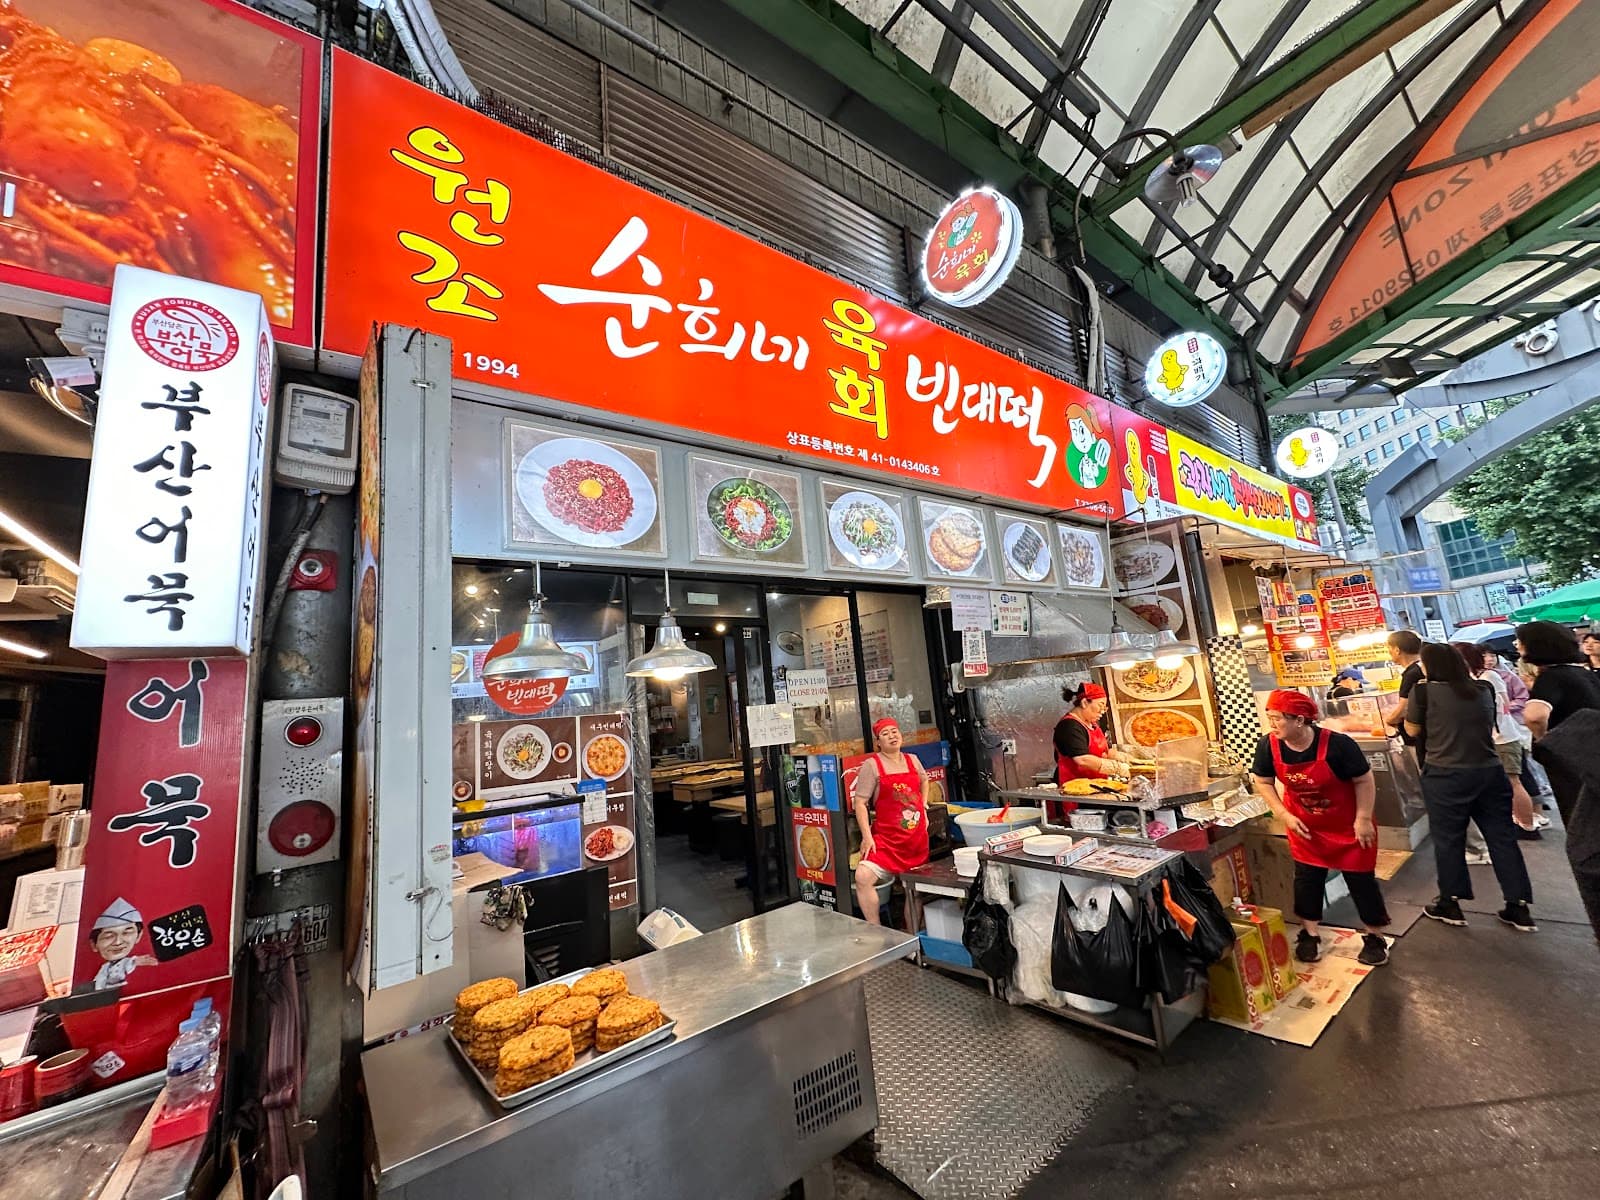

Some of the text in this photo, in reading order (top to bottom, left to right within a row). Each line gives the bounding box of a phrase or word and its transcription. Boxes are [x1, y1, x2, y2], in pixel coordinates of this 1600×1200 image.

[932, 245, 976, 280] 순희네
[955, 249, 989, 280] 육회
[137, 302, 162, 321] BUSAN
[163, 298, 199, 308] EOMUK
[389, 126, 512, 322] 원조
[537, 216, 810, 371] 순희네
[822, 298, 889, 440] 육회
[905, 355, 1057, 488] 빈대떡
[157, 326, 201, 349] 부산
[170, 341, 221, 365] 어묵
[463, 352, 520, 379] 1994
[786, 431, 855, 457] 상표등록번호
[857, 448, 869, 462] 제
[124, 381, 212, 632] 부산어묵
[506, 681, 558, 706] 빈대떡
[788, 678, 809, 687] OPEN
[789, 688, 810, 697] CLOSE
[108, 659, 210, 869] 어묵
[804, 812, 828, 826] 순희네
[152, 925, 206, 950] 장우손
[304, 919, 328, 943] 604
